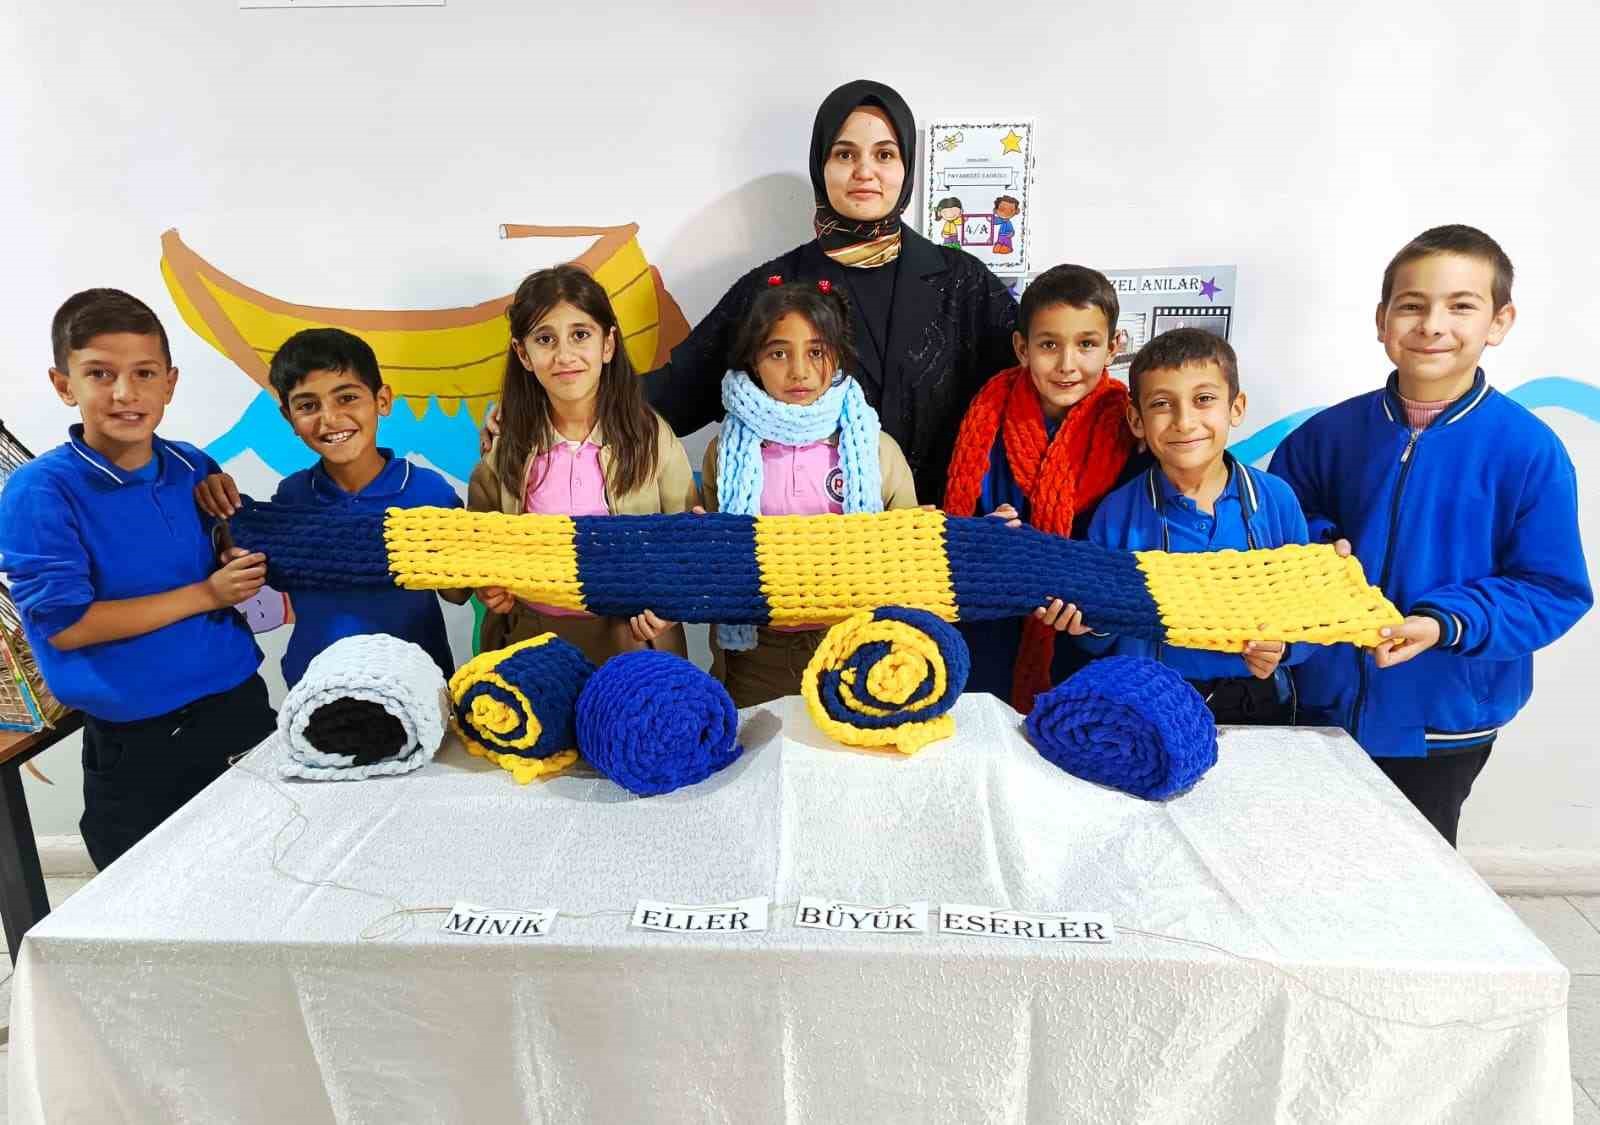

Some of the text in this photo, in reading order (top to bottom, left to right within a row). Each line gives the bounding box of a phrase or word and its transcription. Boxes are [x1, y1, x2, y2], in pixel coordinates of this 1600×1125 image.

[1141, 277, 1199, 291] ANILAR
[446, 905, 1106, 940] MİNİK ELLER BÜYÜK ESERLER
